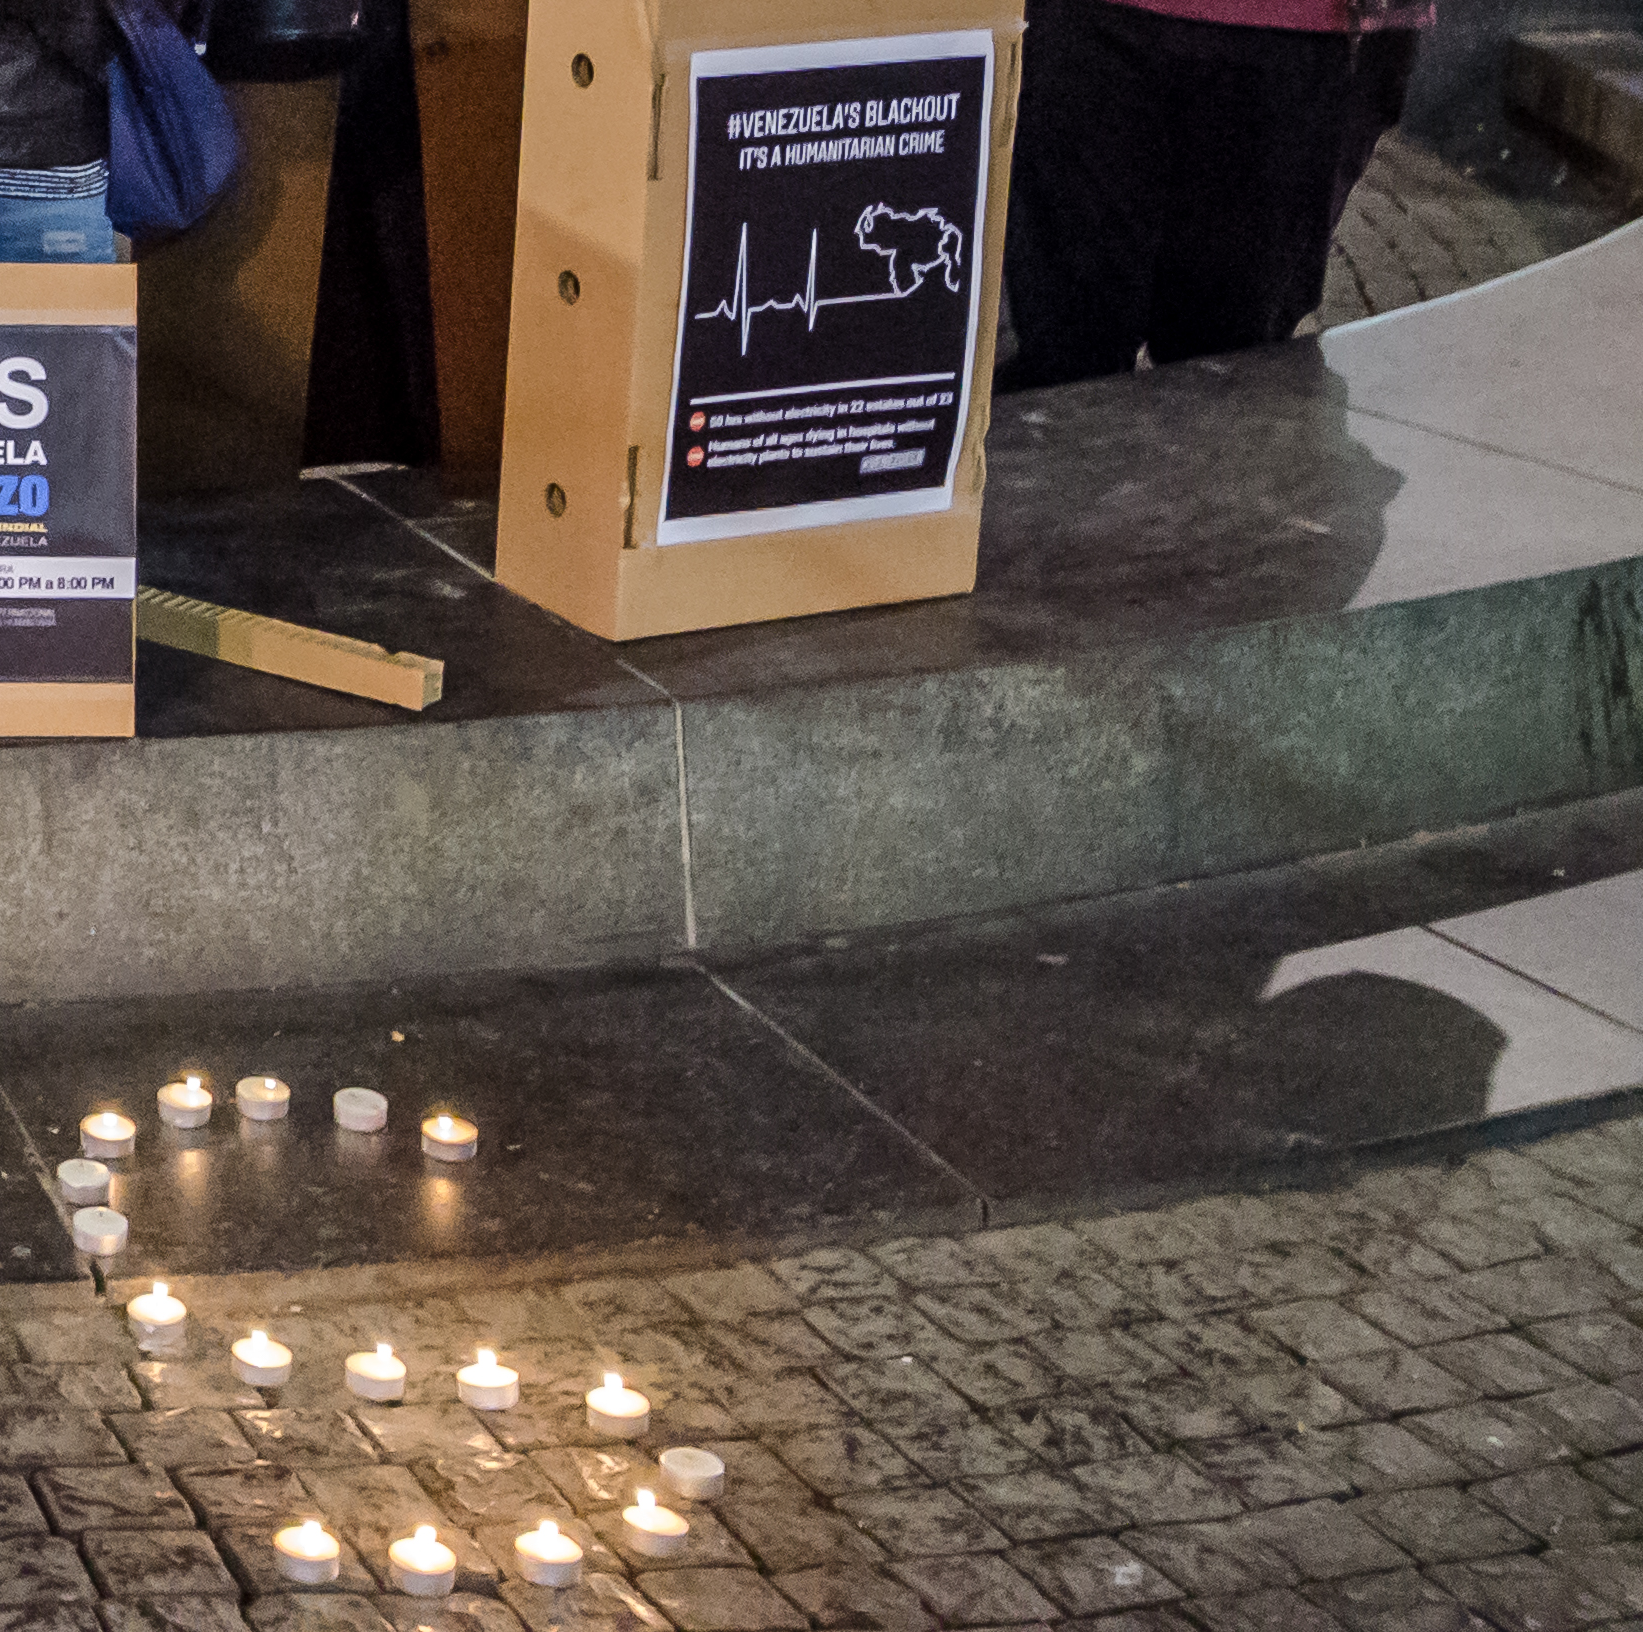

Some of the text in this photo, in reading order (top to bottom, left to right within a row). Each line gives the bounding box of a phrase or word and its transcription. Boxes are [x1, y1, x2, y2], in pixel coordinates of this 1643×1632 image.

[727, 100, 862, 140] #VENEZUELA'S
[739, 128, 946, 171] IT'S A HUMANITARIAN CRIME
[18, 576, 42, 591] PM
[56, 576, 88, 591] 8:00
[91, 576, 115, 591] PM
